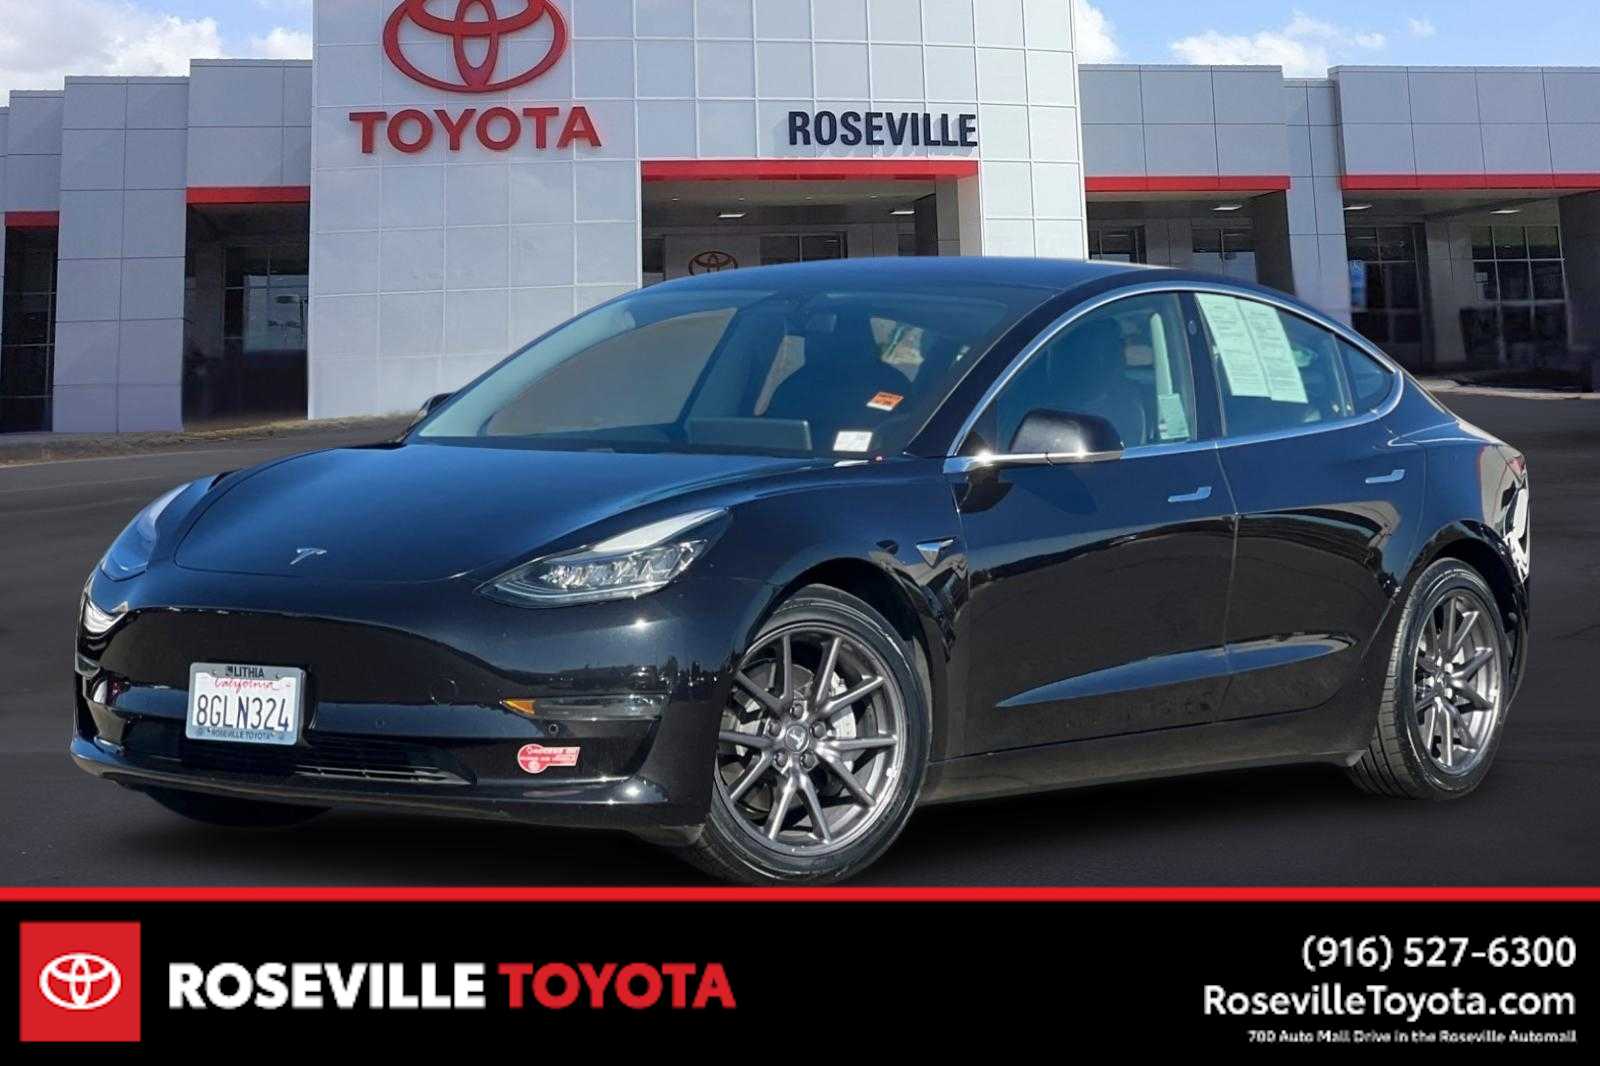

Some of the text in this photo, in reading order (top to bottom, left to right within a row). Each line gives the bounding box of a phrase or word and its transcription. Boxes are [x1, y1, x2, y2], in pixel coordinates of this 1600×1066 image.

[349, 105, 603, 154] TOYOTA
[788, 111, 979, 147] ROSEVILLE
[233, 665, 265, 679] LITHIA
[196, 693, 289, 732] 8GLN324
